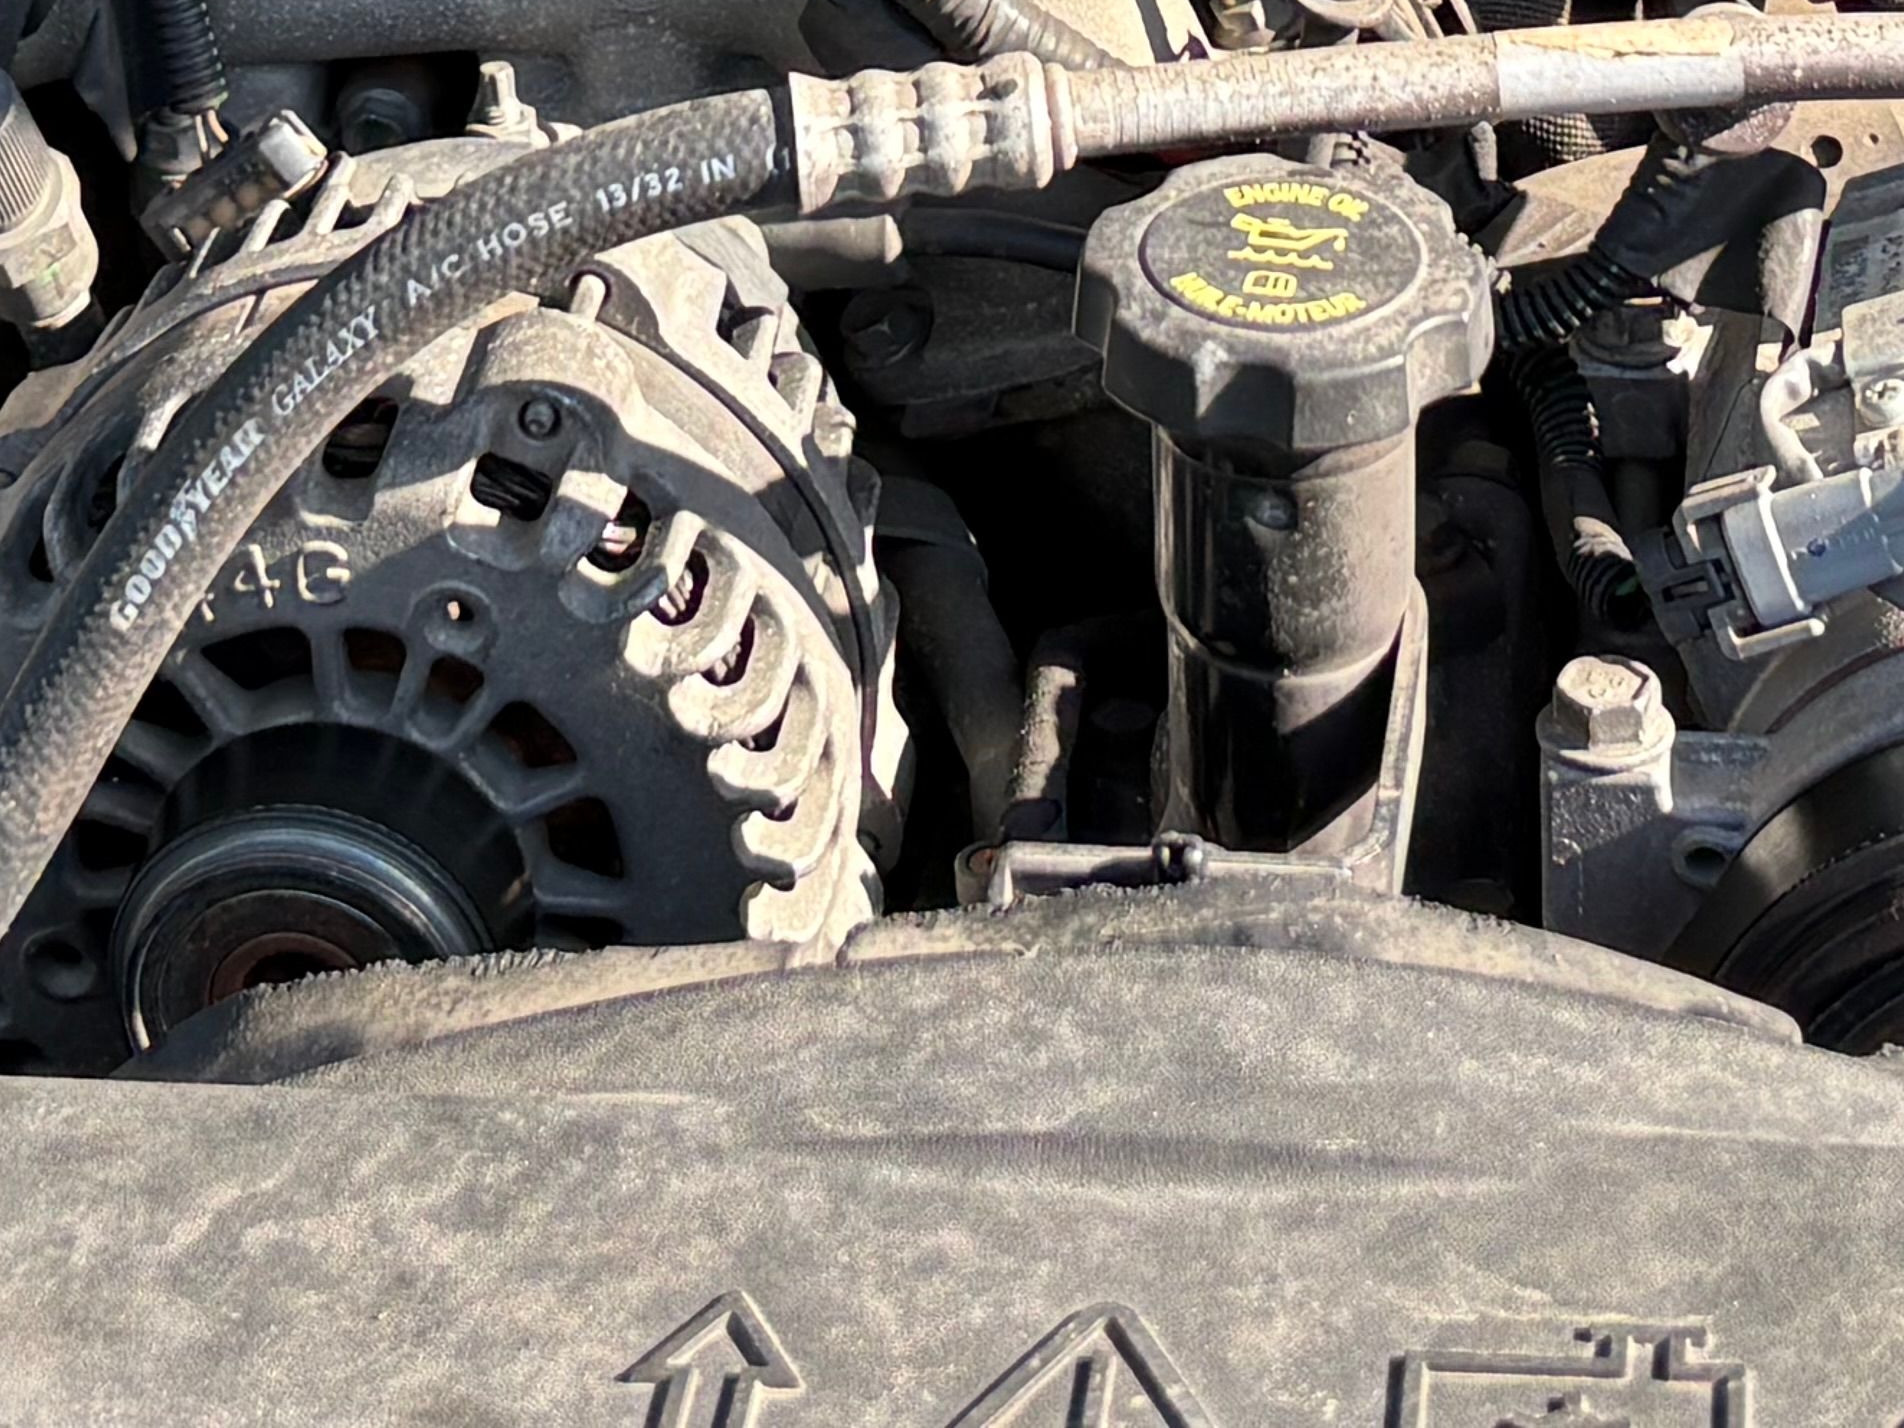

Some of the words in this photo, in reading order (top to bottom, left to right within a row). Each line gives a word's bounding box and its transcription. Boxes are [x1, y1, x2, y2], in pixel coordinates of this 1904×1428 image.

[1223, 182, 1330, 209] ENGINE
[1328, 182, 1370, 223] OIL
[1168, 271, 1367, 325] HUILE-MOTEUR
[108, 419, 267, 635] GOODYEAR
[271, 309, 381, 417] GALAXY
[405, 248, 470, 308] A/C
[476, 201, 573, 267] HOSE
[594, 166, 684, 213] 13/32
[700, 152, 736, 185] IN
